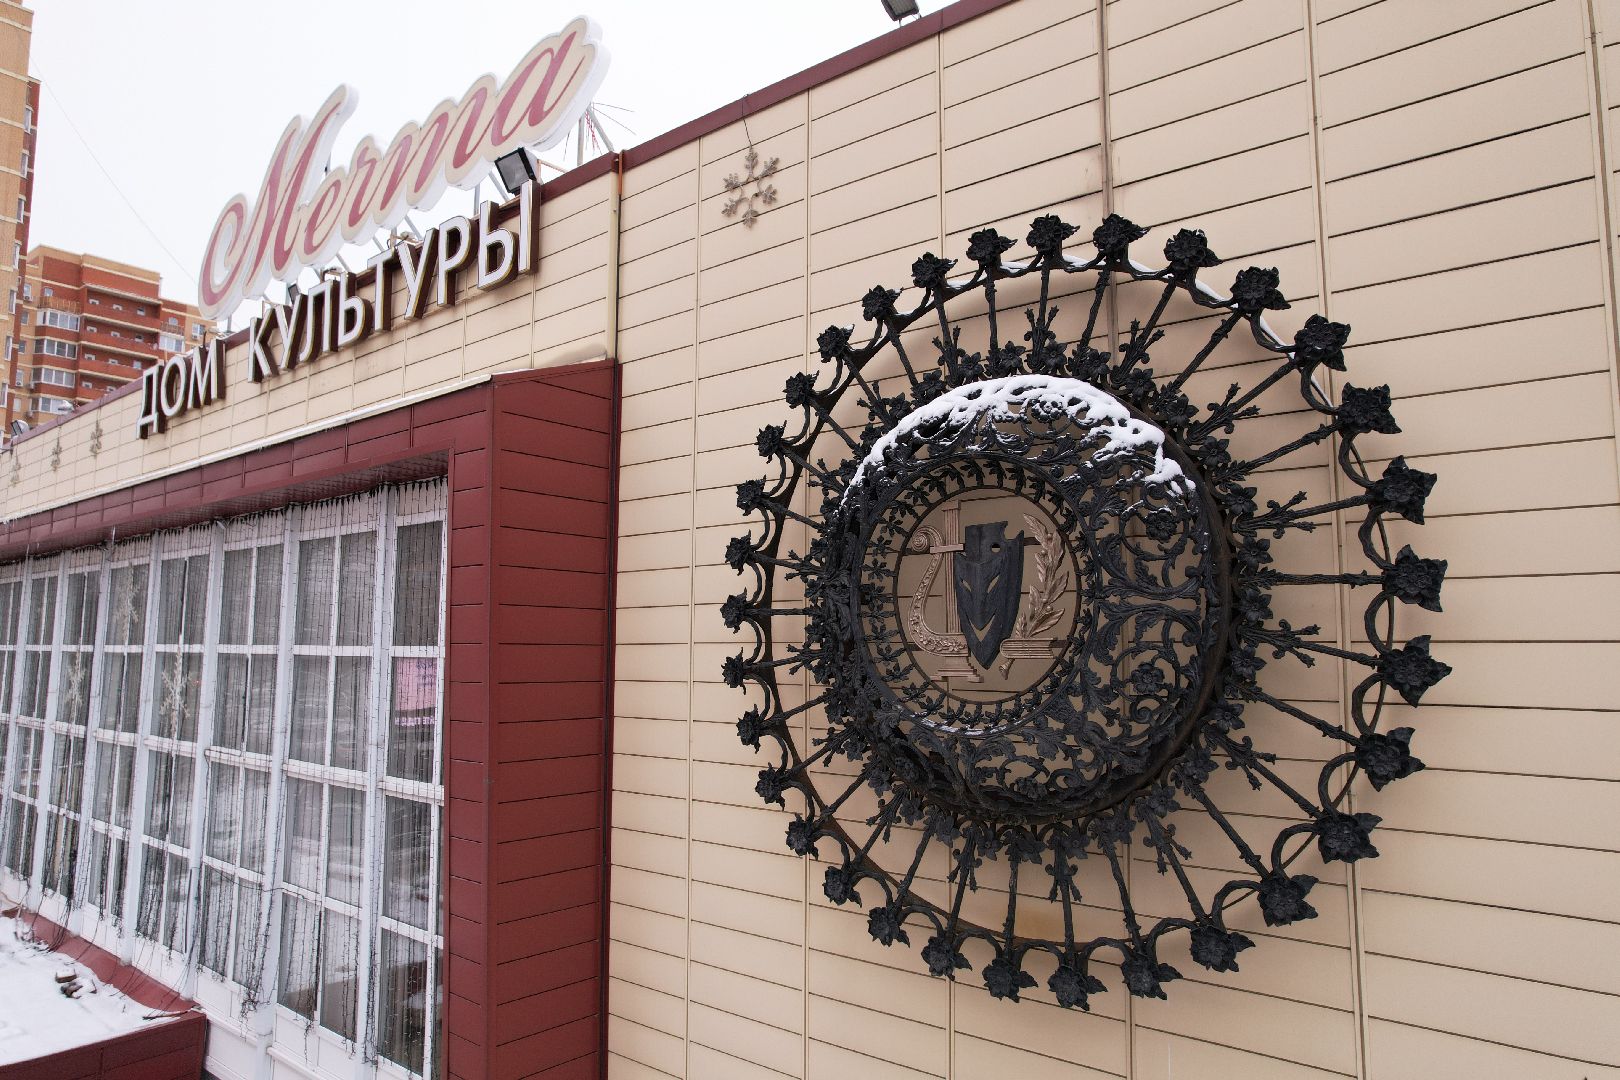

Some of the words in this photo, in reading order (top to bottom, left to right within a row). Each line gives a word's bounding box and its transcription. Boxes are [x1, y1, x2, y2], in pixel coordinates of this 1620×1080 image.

[202, 28, 587, 307] Мечта
[136, 338, 224, 440] ДОМ
[248, 179, 538, 383] КУЛЬТУРЫ
